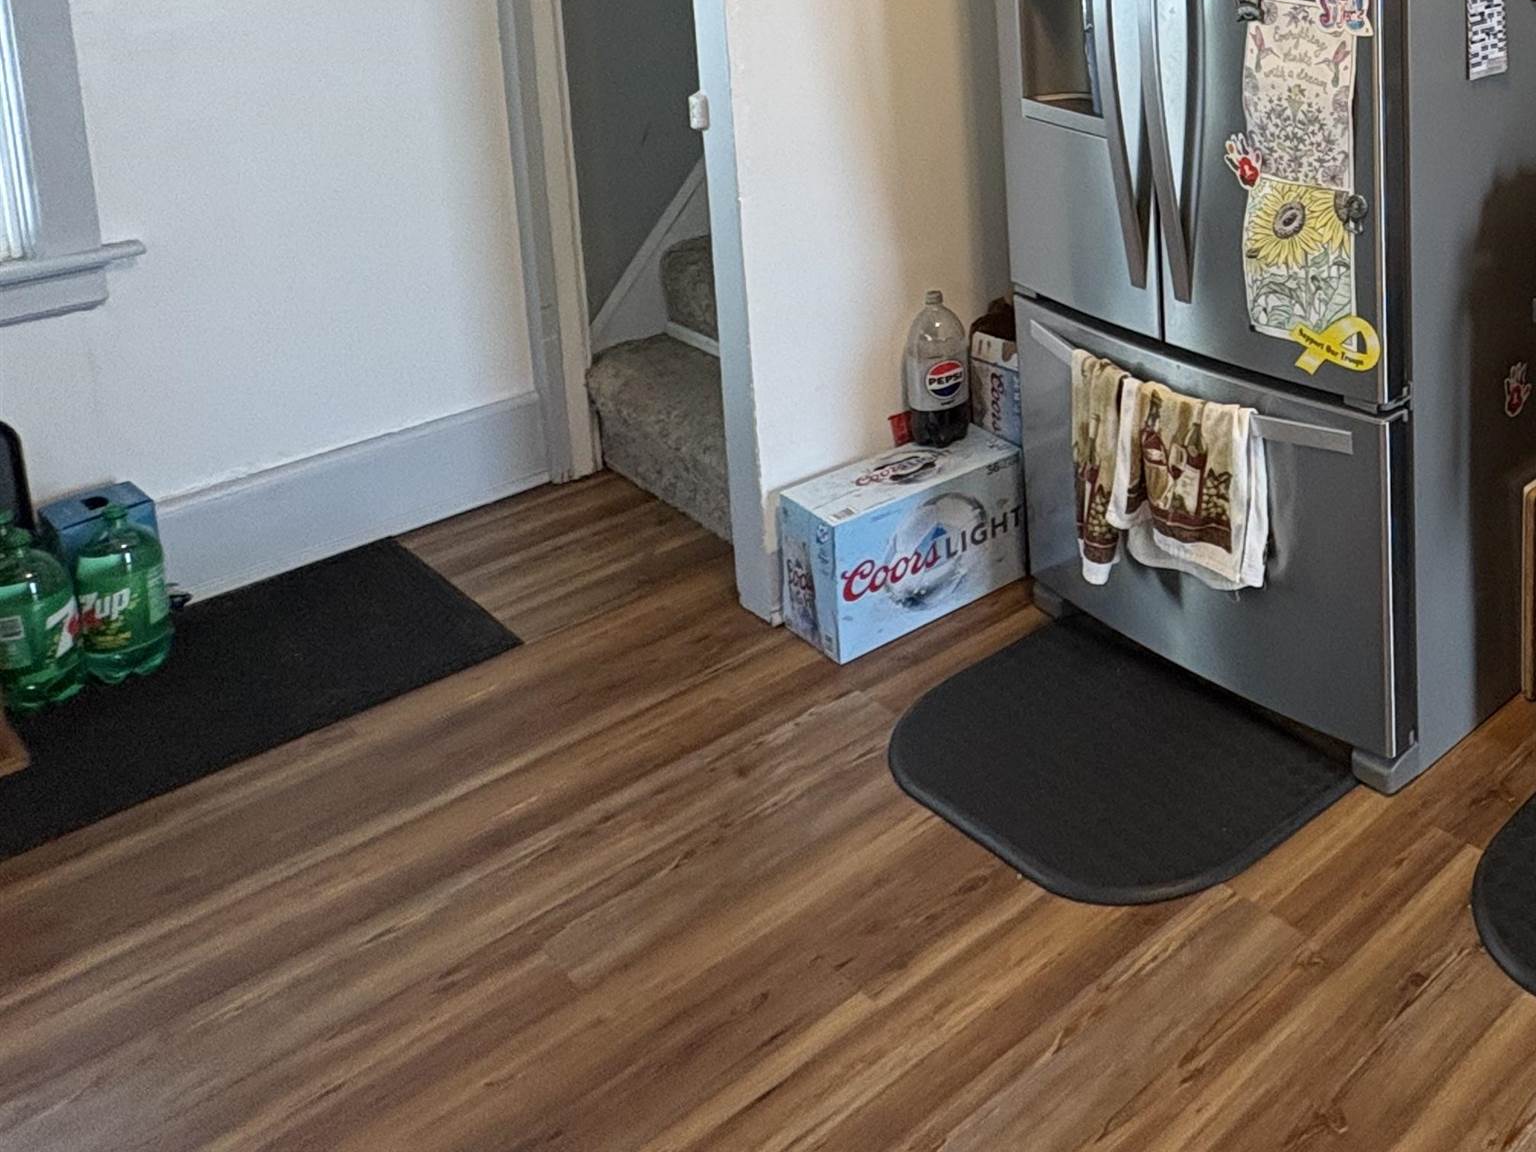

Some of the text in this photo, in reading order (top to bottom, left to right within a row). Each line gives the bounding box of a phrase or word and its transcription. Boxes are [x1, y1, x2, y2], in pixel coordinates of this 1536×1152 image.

[1272, 24, 1329, 59] Everything
[1264, 65, 1287, 81] with
[1298, 328, 1365, 368] Support Our Troops
[928, 371, 963, 386] PEPSI
[841, 542, 941, 602] Coors
[945, 504, 1023, 558] LIGHT
